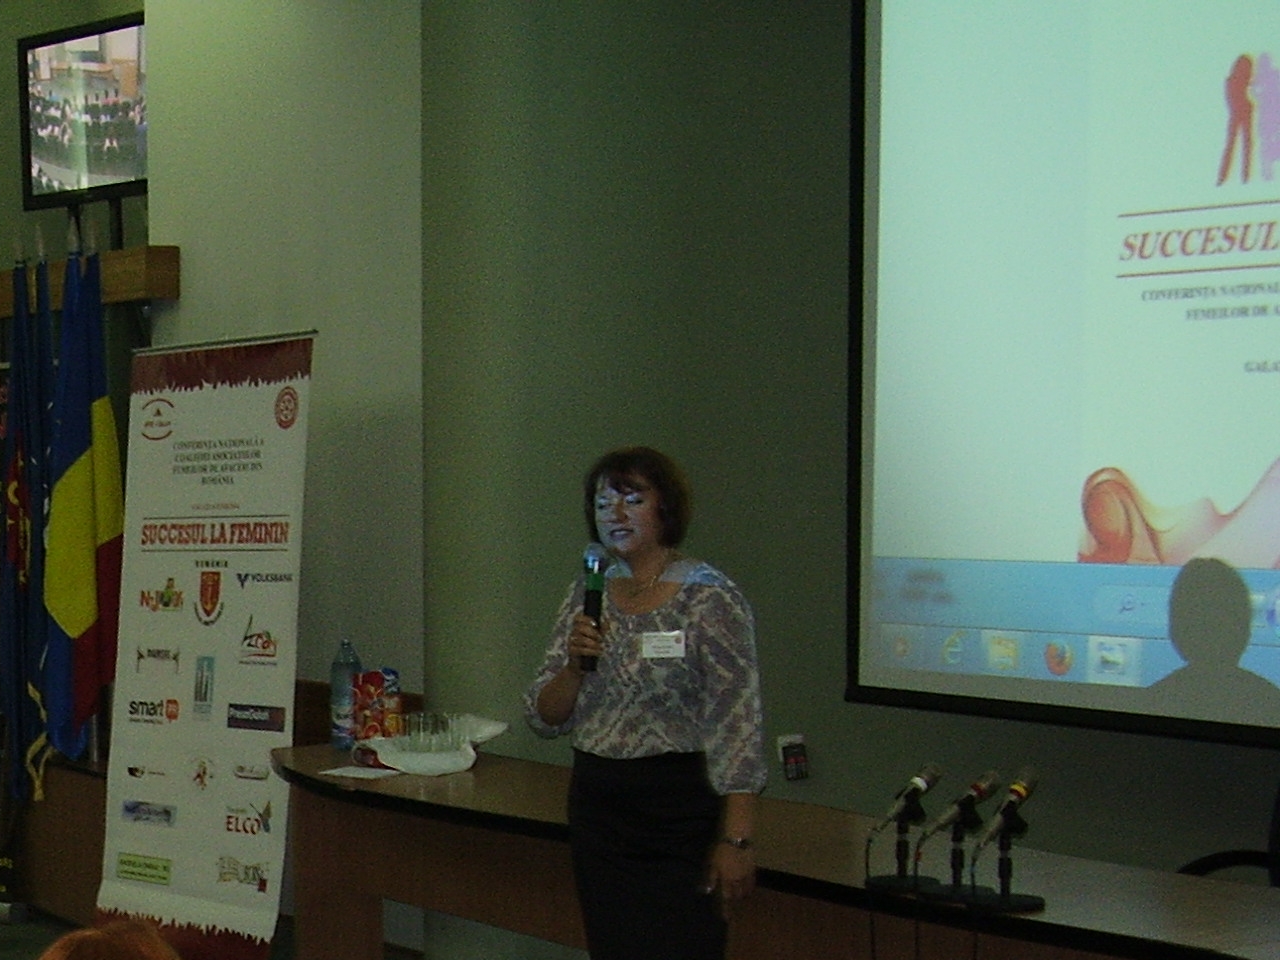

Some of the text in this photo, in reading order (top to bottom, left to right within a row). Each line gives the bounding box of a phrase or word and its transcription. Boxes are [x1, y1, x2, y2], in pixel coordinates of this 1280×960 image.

[1119, 220, 1280, 261] SUCCESUL
[141, 521, 290, 546] SUCCESUL LA FEMININ
[128, 699, 164, 717] smart
[225, 815, 262, 835] ELCO
